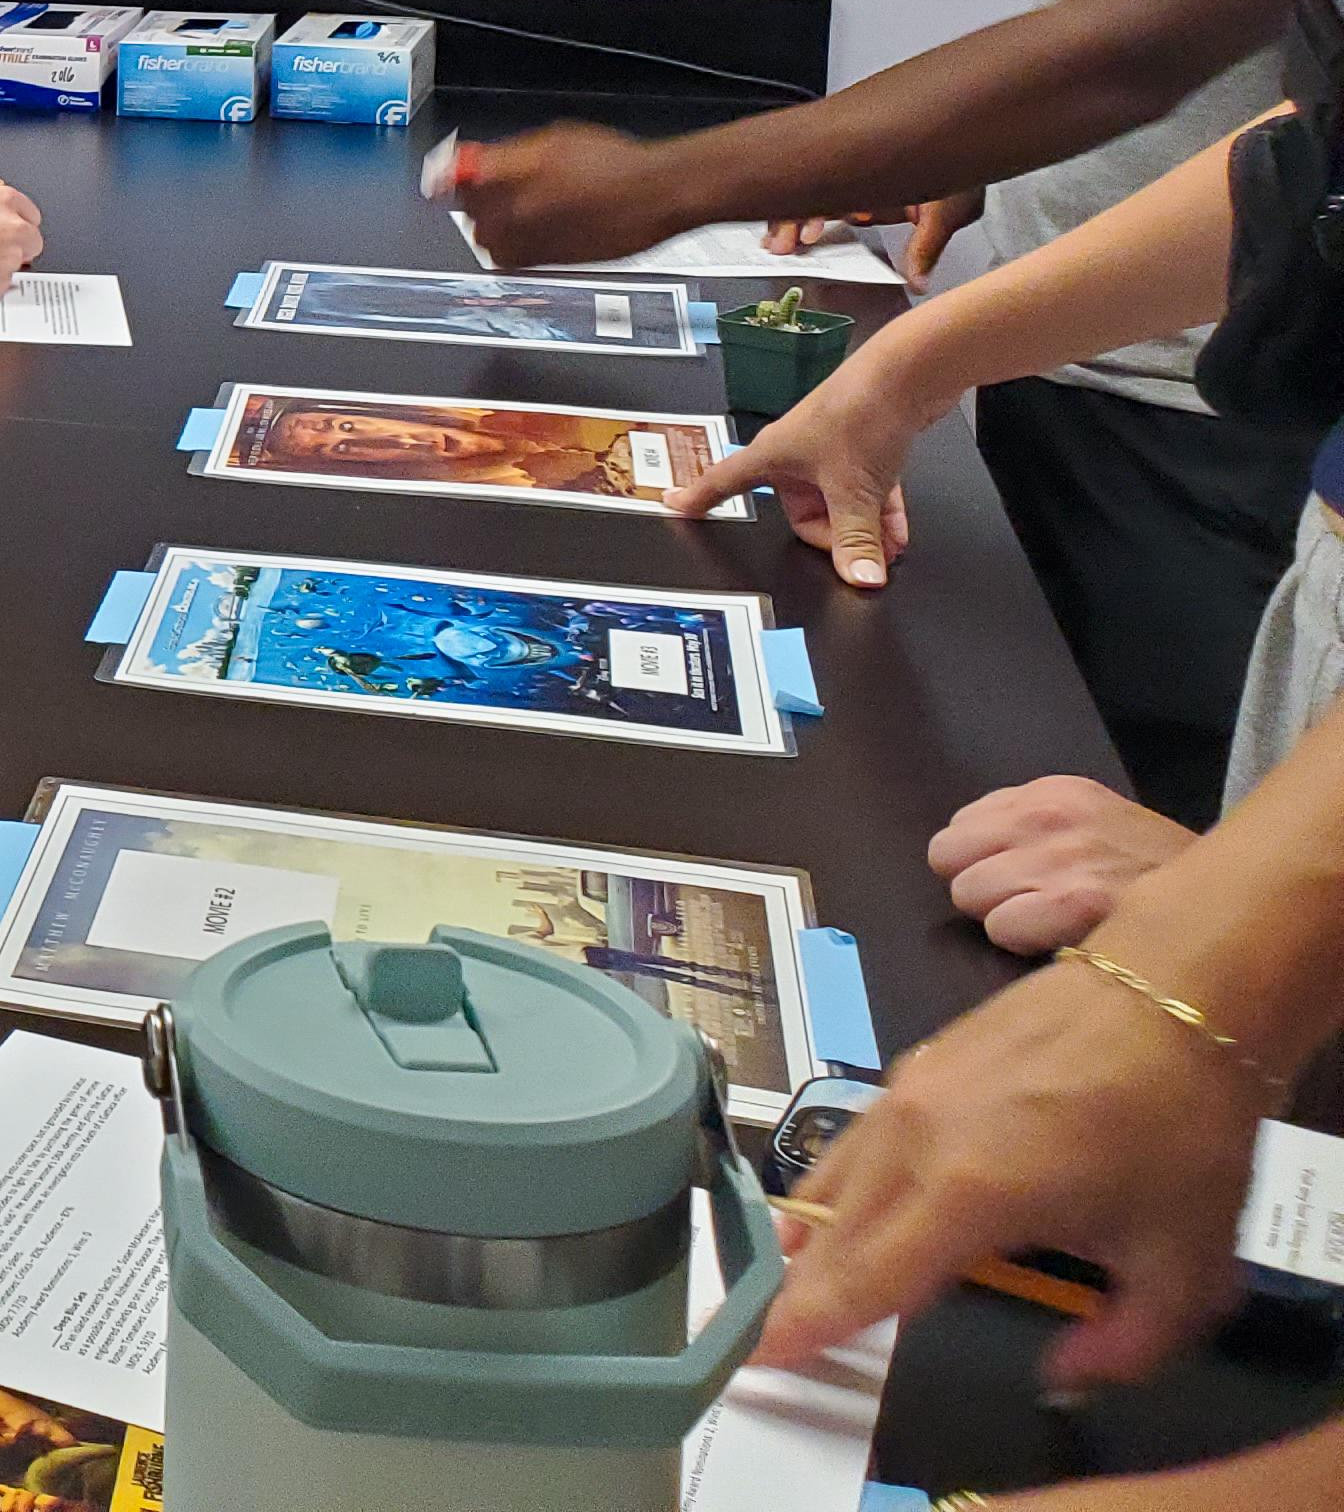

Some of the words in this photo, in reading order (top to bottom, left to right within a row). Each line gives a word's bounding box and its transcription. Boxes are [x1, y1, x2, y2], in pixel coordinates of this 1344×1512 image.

[138, 55, 229, 73] fisherbrand
[293, 55, 387, 75] fisherbrand
[52, 67, 74, 82] 2016
[214, 888, 235, 900] #2
[203, 900, 232, 934] MOVIE
[53, 1316, 72, 1332] Deep
[64, 1303, 80, 1316] Blue
[73, 1292, 87, 1302] Sea
